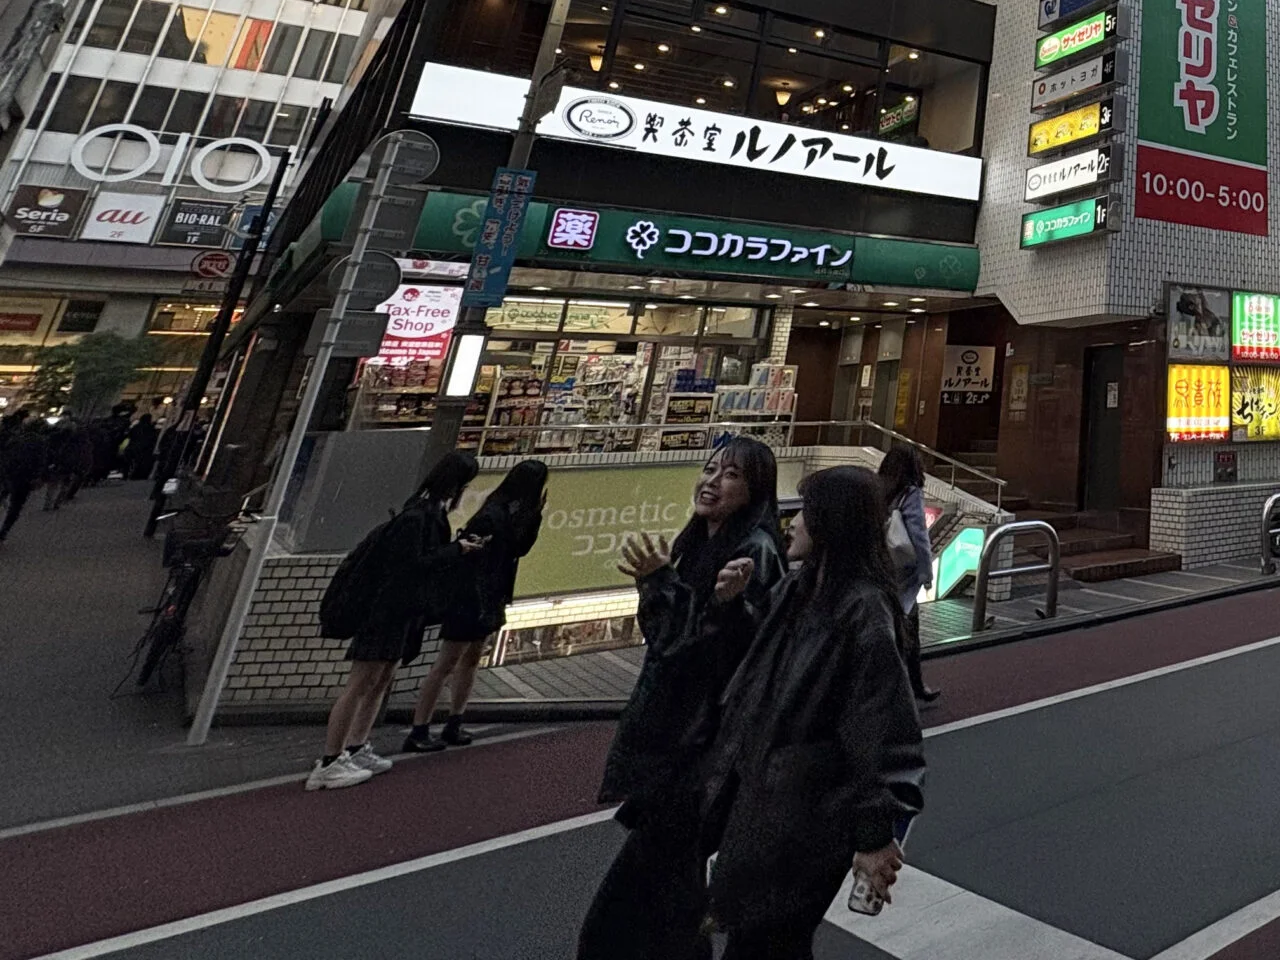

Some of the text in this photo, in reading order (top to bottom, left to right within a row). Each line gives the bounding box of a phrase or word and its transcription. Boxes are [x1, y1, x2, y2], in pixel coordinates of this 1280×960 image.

[1105, 15, 1117, 32] 5F
[1062, 22, 1103, 50] サイゼリヤ
[1050, 64, 1099, 94] ホットヨガ
[1101, 106, 1112, 125] 3F
[642, 112, 896, 181] 喫茶室ルノアール
[1098, 153, 1110, 174] 2F
[1142, 171, 1265, 212] 10:00-5:00
[14, 207, 70, 222] Seria
[96, 208, 150, 225] au
[175, 212, 222, 227] BIO-RAL
[1044, 212, 1091, 232] ココカラファイン
[1095, 205, 1107, 224] 1F
[553, 213, 595, 247] 薬
[665, 229, 853, 268] ココカラファイン
[385, 303, 451, 318] Tax-Free
[391, 318, 435, 333] Shop
[944, 378, 990, 388] ルノアール
[965, 391, 978, 404] 2F
[1255, 426, 1266, 436] 3F
[546, 496, 680, 530] osmetic
